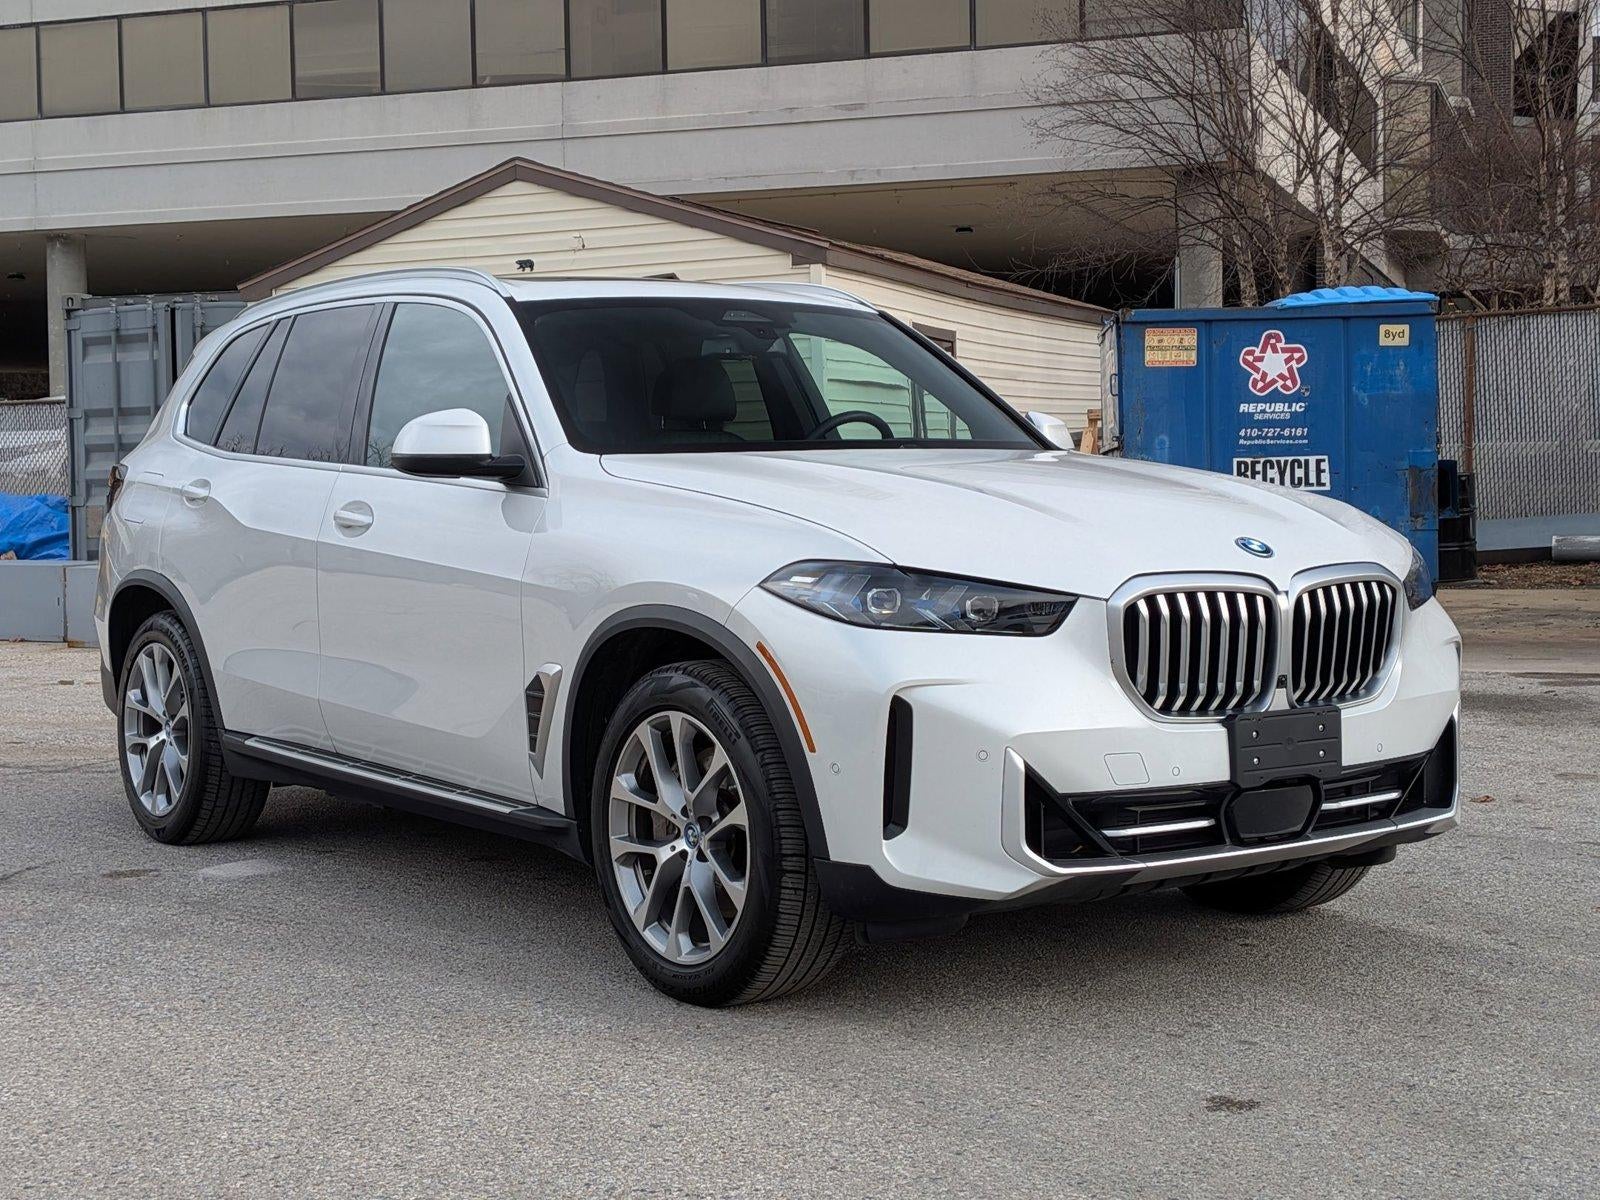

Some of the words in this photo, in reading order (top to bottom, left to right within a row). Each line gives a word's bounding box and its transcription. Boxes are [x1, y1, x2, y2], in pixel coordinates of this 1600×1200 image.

[1384, 329, 1405, 341] 8yd
[1239, 402, 1306, 413] REPUBLIC
[1239, 427, 1308, 437] 410-727-6161
[1236, 458, 1327, 488] RECYCLE
